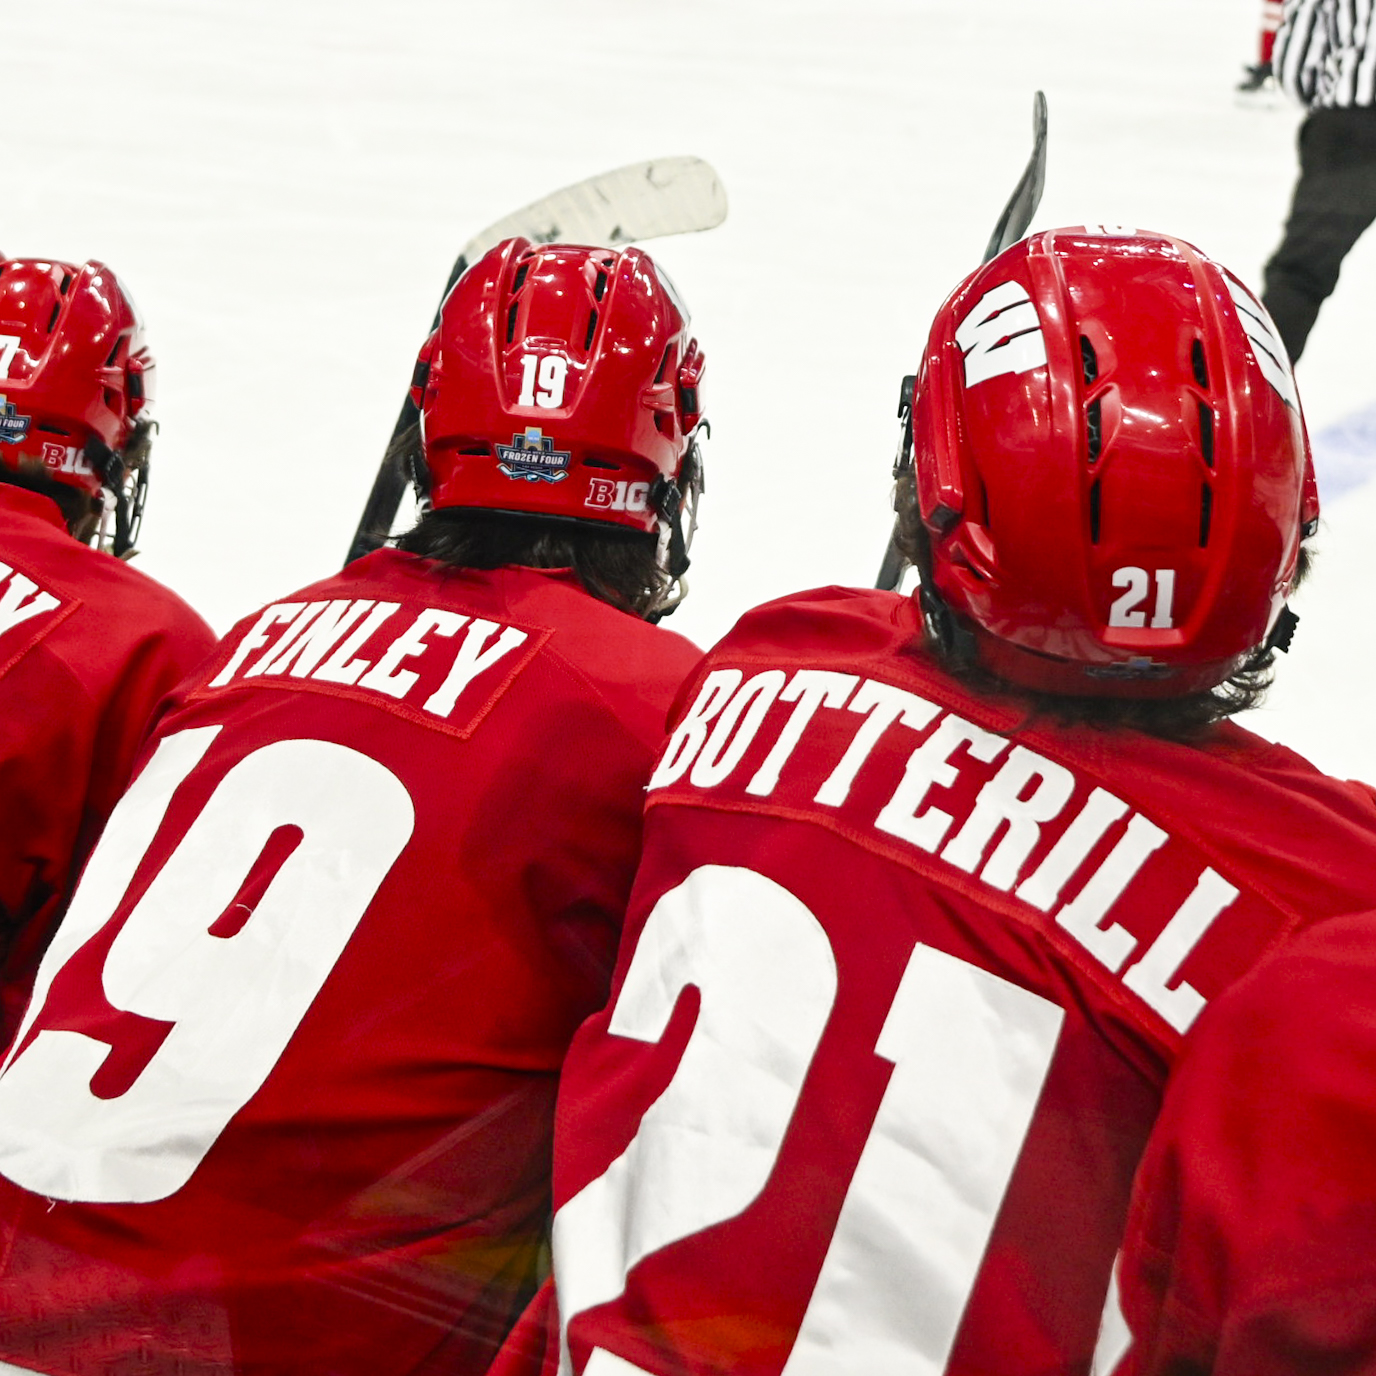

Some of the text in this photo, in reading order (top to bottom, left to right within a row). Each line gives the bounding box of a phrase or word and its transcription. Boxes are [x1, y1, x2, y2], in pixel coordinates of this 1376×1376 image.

[518, 354, 567, 409] 19
[3, 419, 25, 428] FOUR
[502, 450, 539, 463] FROZEN
[539, 455, 565, 465] FOUR
[1108, 566, 1175, 629] 21
[208, 598, 529, 718] FINLEY
[644, 668, 1240, 1037] BOTTERILL
[552, 864, 1066, 1376] 21
